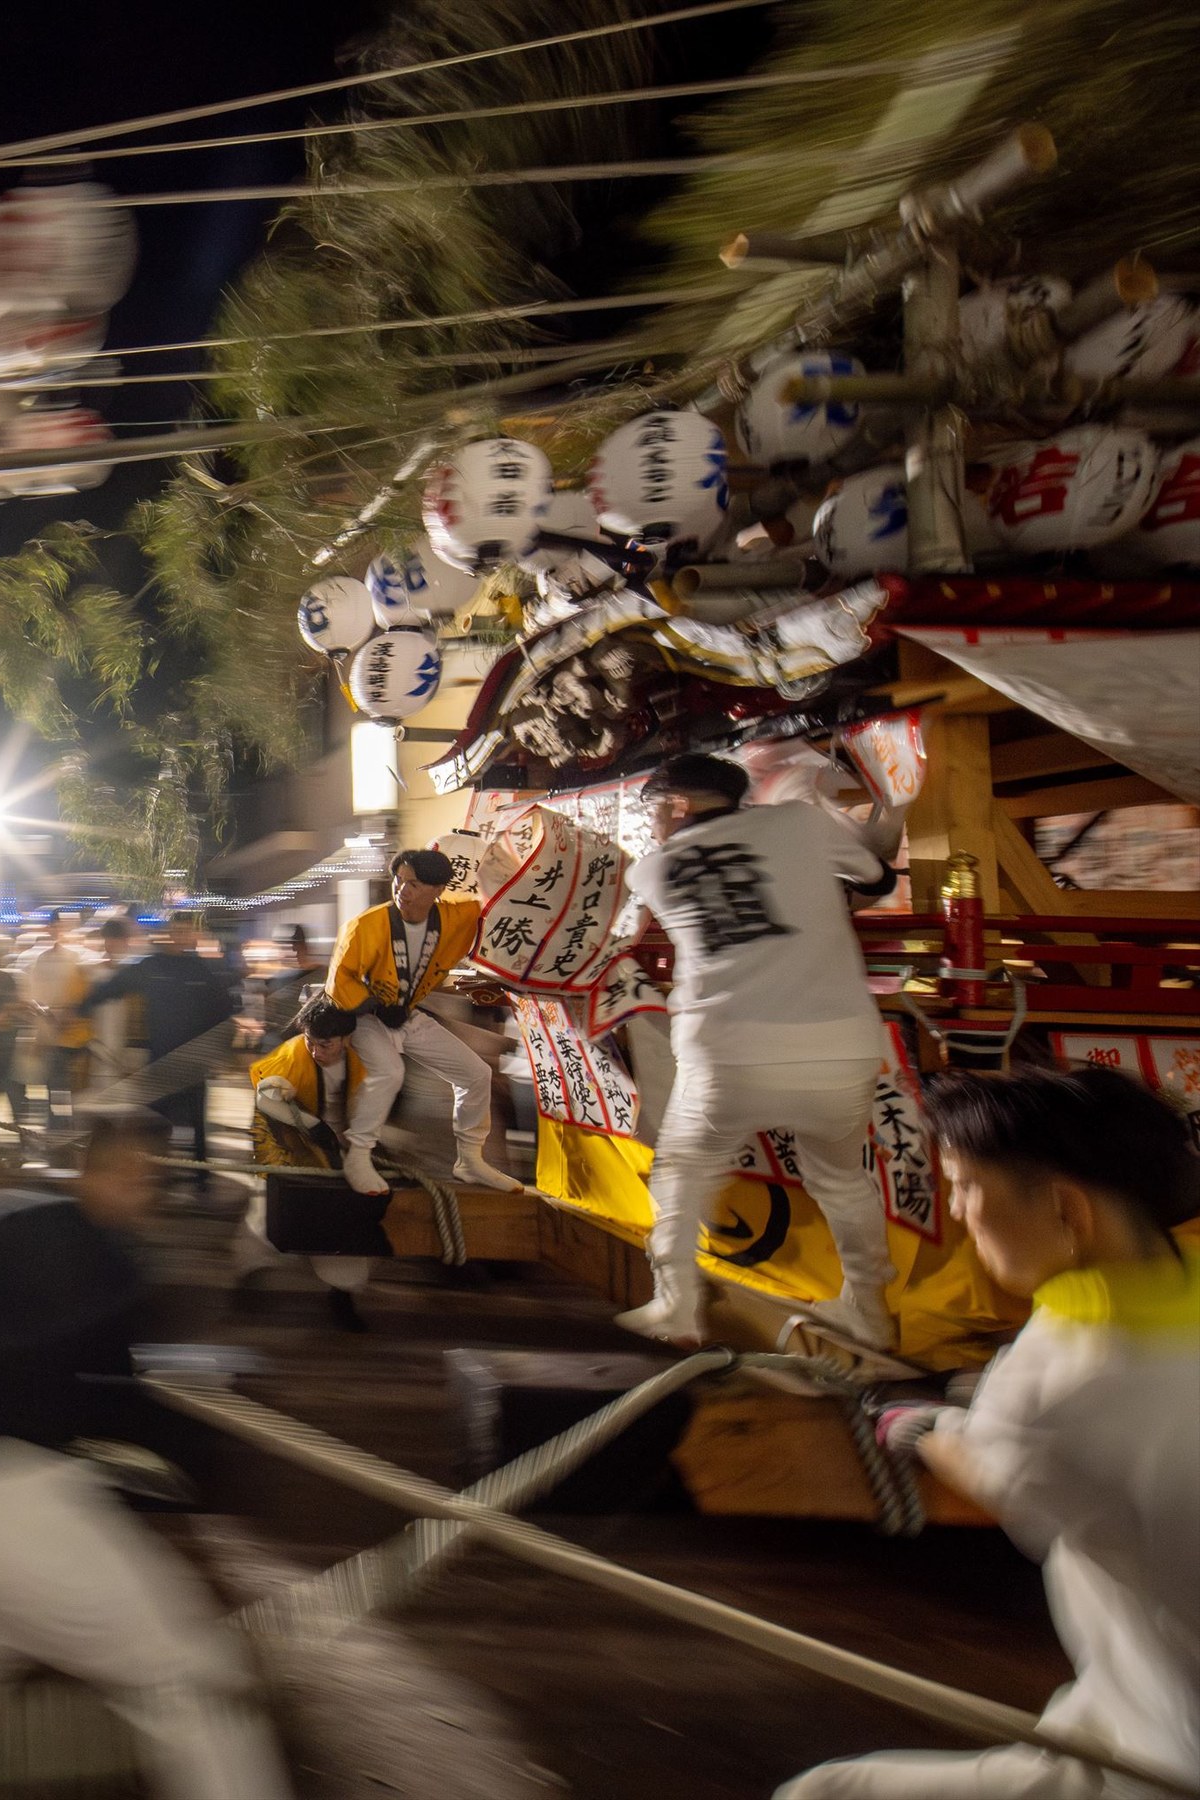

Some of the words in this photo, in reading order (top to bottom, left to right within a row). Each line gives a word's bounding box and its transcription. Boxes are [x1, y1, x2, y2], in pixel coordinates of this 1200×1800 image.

[486, 859, 565, 957] 井上勝
[543, 853, 616, 977] 野口貴史
